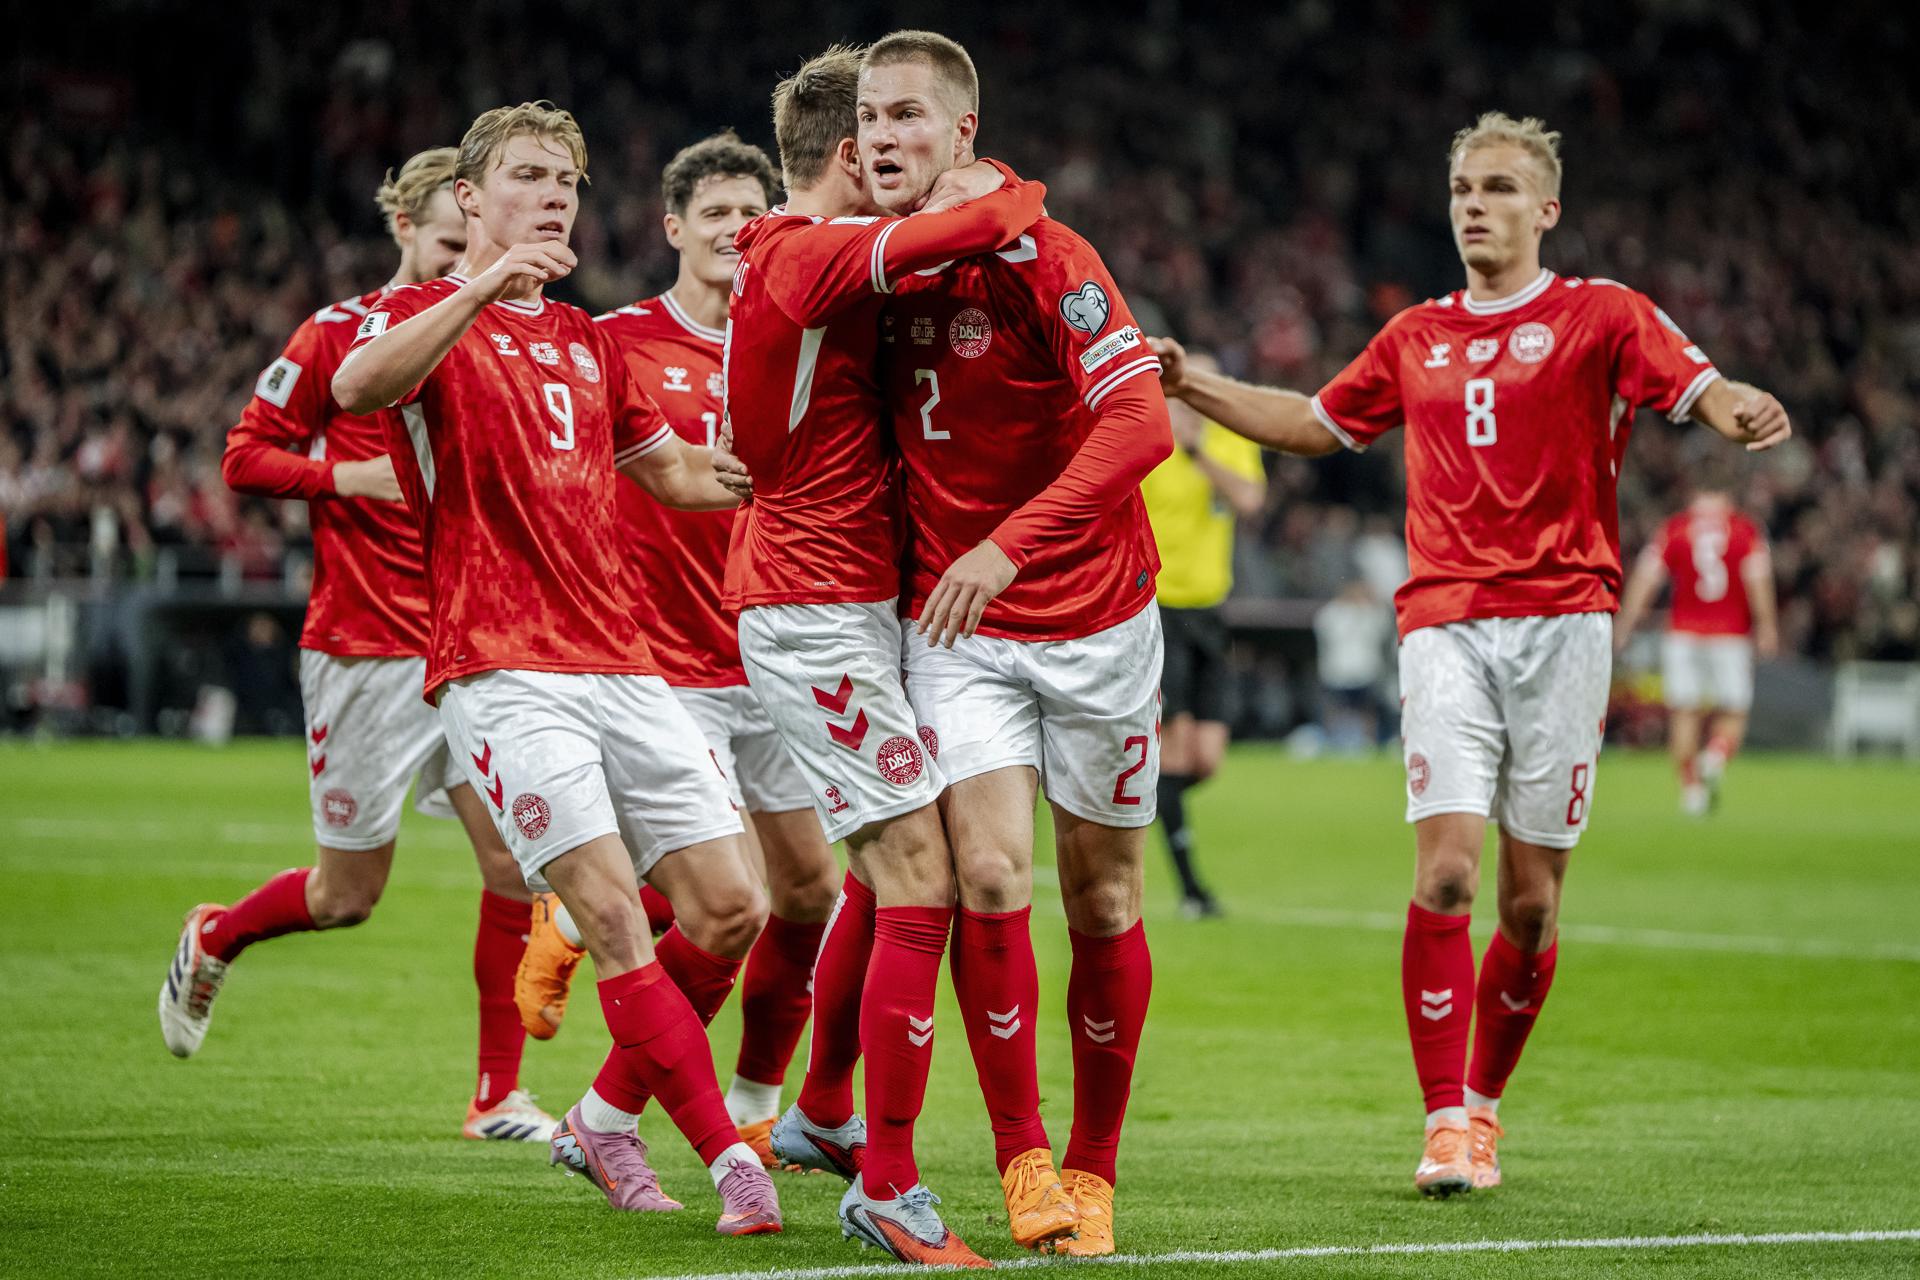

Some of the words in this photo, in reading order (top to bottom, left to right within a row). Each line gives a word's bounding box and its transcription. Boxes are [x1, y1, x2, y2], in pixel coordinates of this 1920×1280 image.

[958, 324, 982, 340] DBU
[961, 349, 979, 357] 1889
[1083, 338, 1121, 366] FOUNDATION
[543, 382, 575, 451] 9
[915, 368, 951, 440] 2
[1465, 377, 1498, 447] 8
[878, 757, 897, 783] DANSK
[886, 749, 914, 771] DBU
[911, 744, 922, 771] UNION
[1112, 735, 1149, 805] 2
[900, 772, 917, 784] 1889
[1566, 763, 1588, 826] 8
[518, 804, 541, 827] DBU
